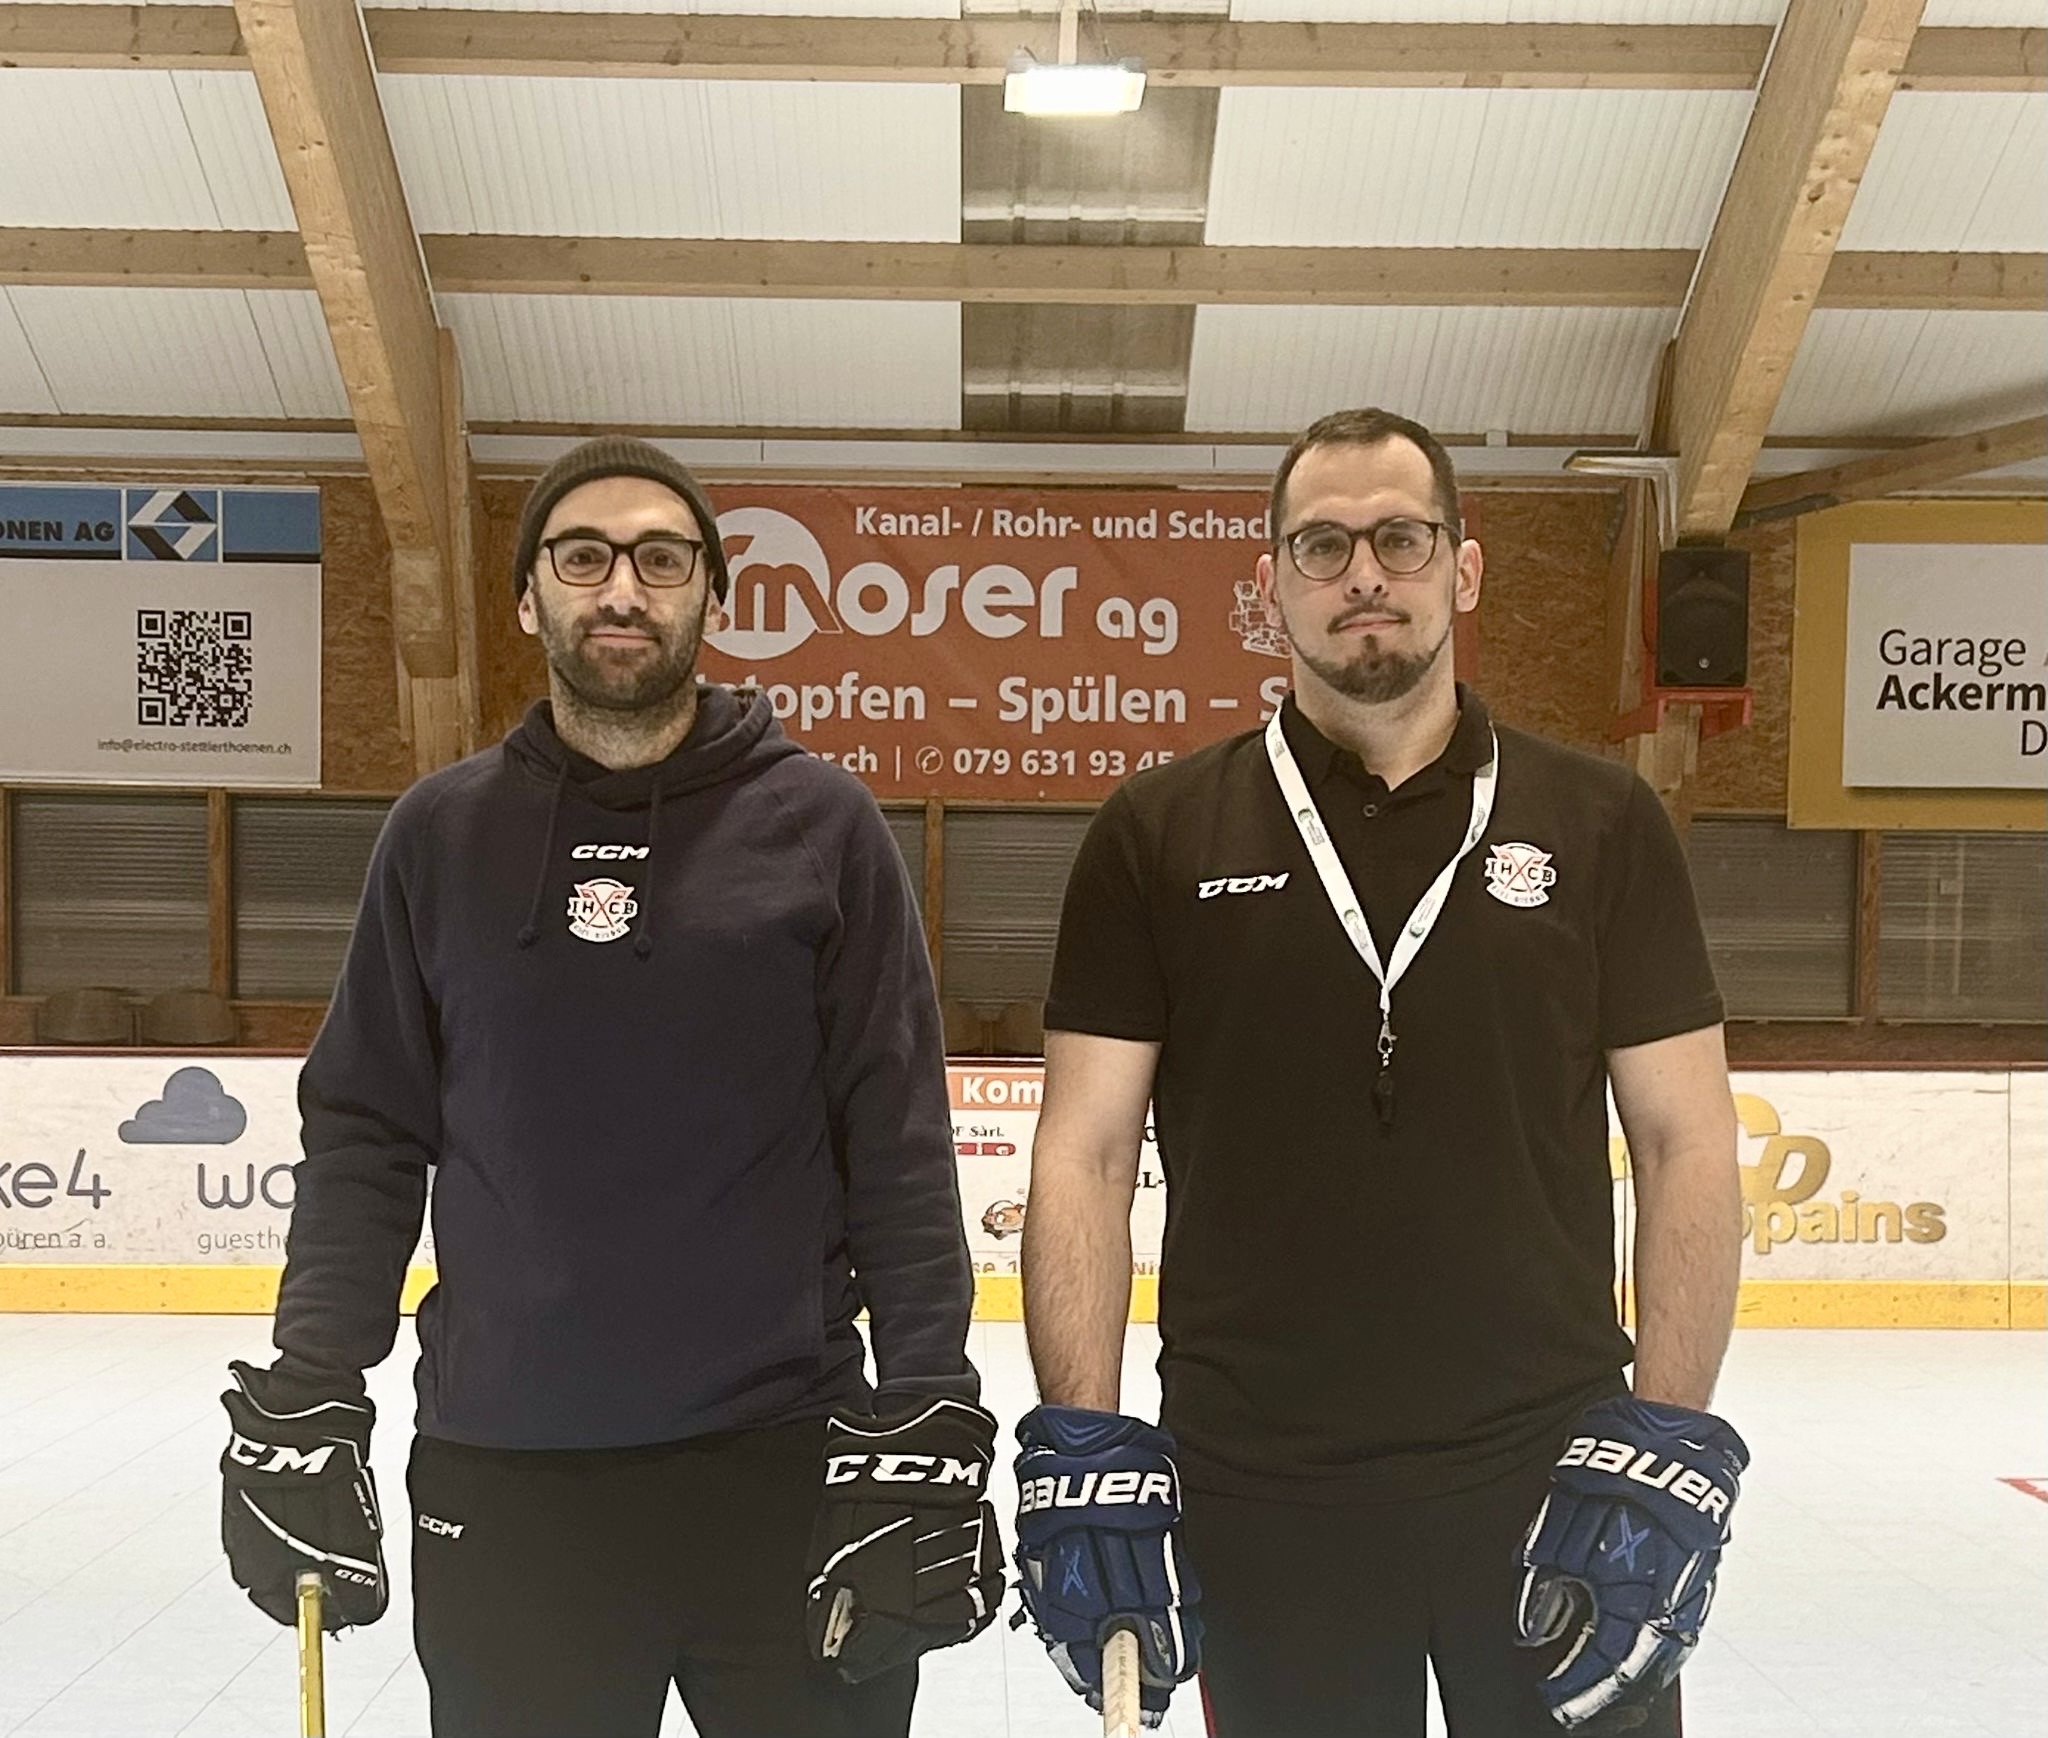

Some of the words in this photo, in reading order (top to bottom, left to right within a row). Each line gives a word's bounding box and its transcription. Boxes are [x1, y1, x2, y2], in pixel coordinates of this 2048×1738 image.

[0, 520, 64, 541] NEN
[73, 520, 115, 542] AG
[855, 506, 962, 535] Kanal-
[992, 510, 1081, 538] Rohr-
[1092, 510, 1157, 540] und
[1096, 597, 1179, 655] ag
[1879, 628, 2027, 678] Garage
[998, 675, 1187, 735] Spülen
[1876, 672, 2046, 711] Ackerm
[953, 748, 1011, 775] 079
[1020, 750, 1077, 776] 631
[1088, 750, 1127, 777] 93
[571, 844, 650, 860] CCM
[1199, 872, 1290, 900] CCM
[0, 1227, 61, 1249] üren
[1742, 1190, 1948, 1255] pains
[825, 1454, 982, 1486] CCM
[418, 1513, 465, 1539] CCM
